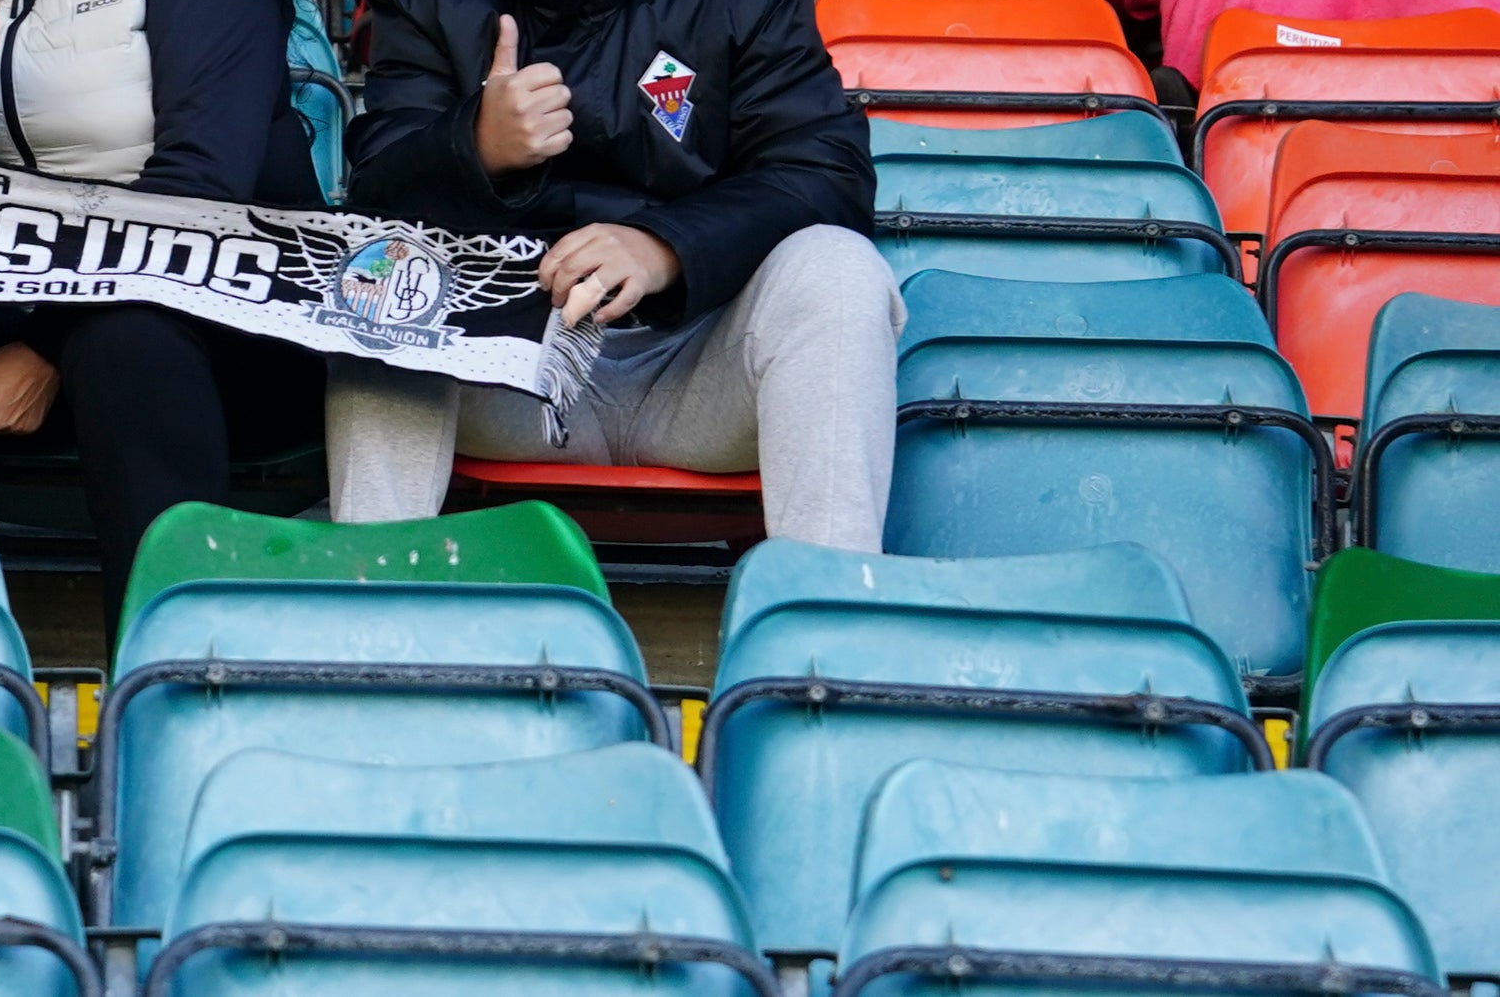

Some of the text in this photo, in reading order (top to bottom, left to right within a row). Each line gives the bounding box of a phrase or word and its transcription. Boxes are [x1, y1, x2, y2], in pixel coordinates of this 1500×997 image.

[76, 216, 280, 303] UDS
[14, 279, 117, 297] SOLA
[323, 315, 430, 347] HALA UNION
